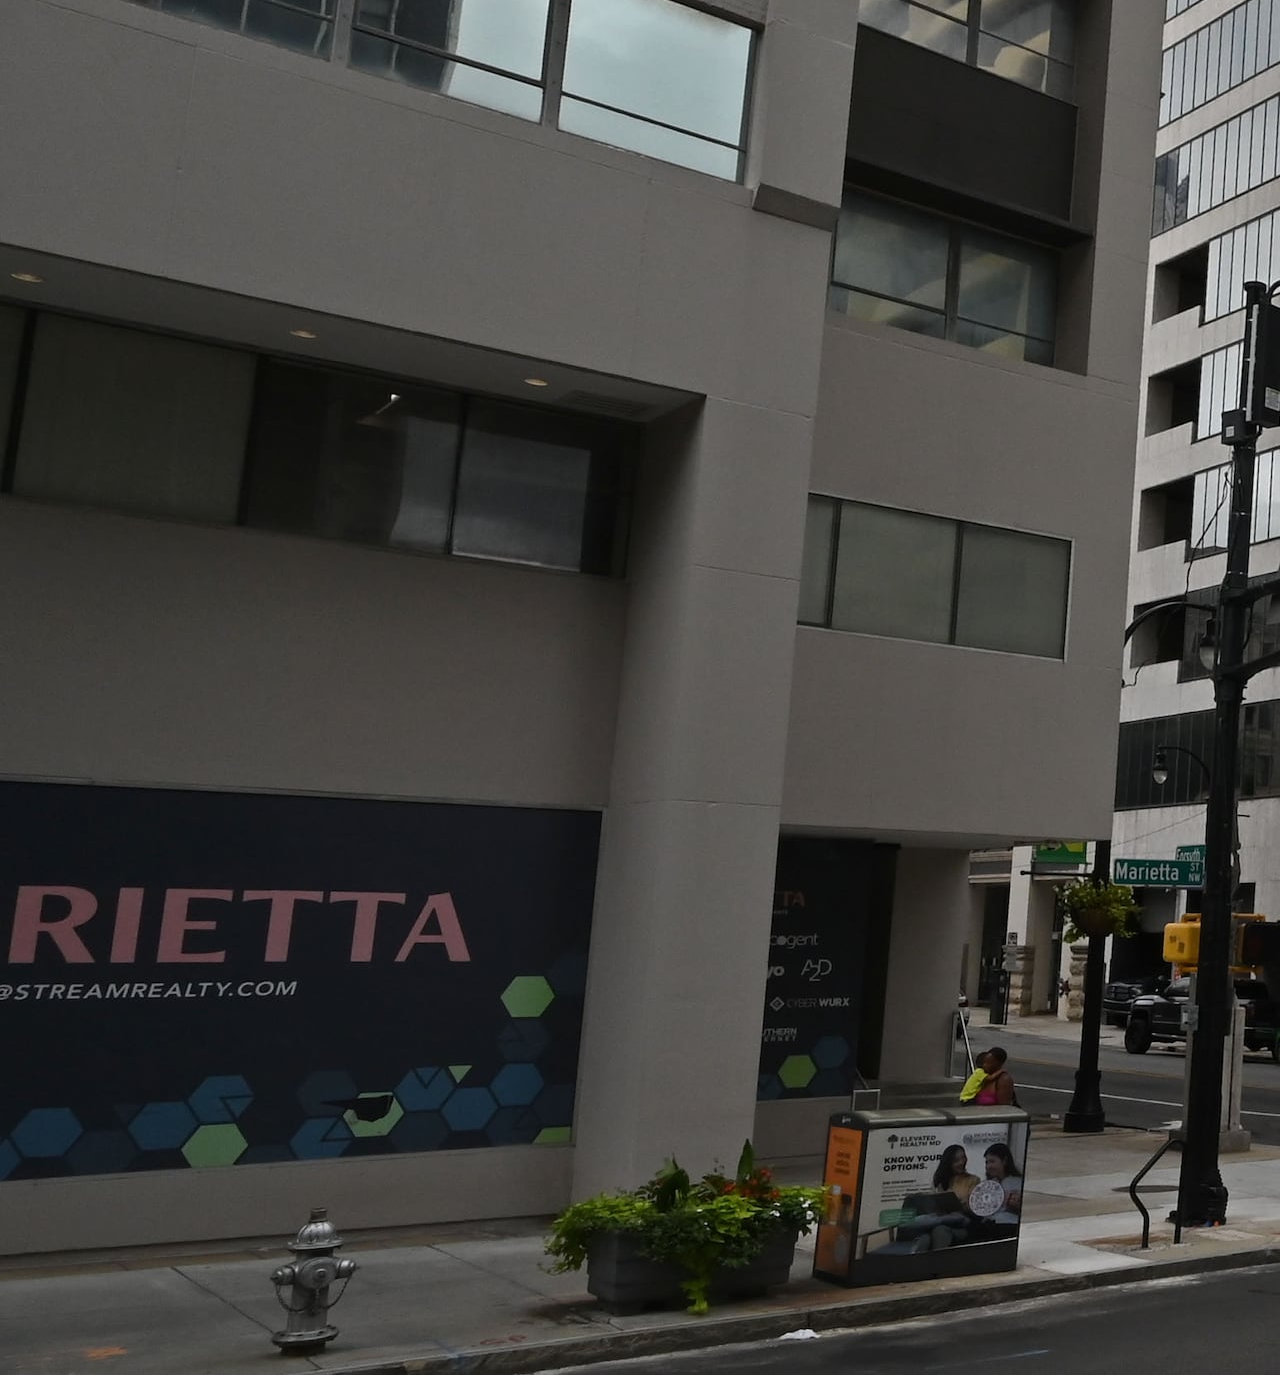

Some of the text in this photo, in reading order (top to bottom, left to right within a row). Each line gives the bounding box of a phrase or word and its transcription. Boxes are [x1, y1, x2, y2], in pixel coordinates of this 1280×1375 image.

[1115, 861, 1180, 881] Marietta
[1190, 863, 1200, 872] ST
[1188, 873, 1201, 882] NW
[8, 884, 472, 964] RIETTA
[769, 933, 820, 950] cogent
[0, 980, 298, 1002] @STREAMREALTY.COM
[819, 997, 850, 1007] WURX
[884, 1156, 914, 1164] KNOW
[883, 1163, 928, 1172] OPTIONS.
